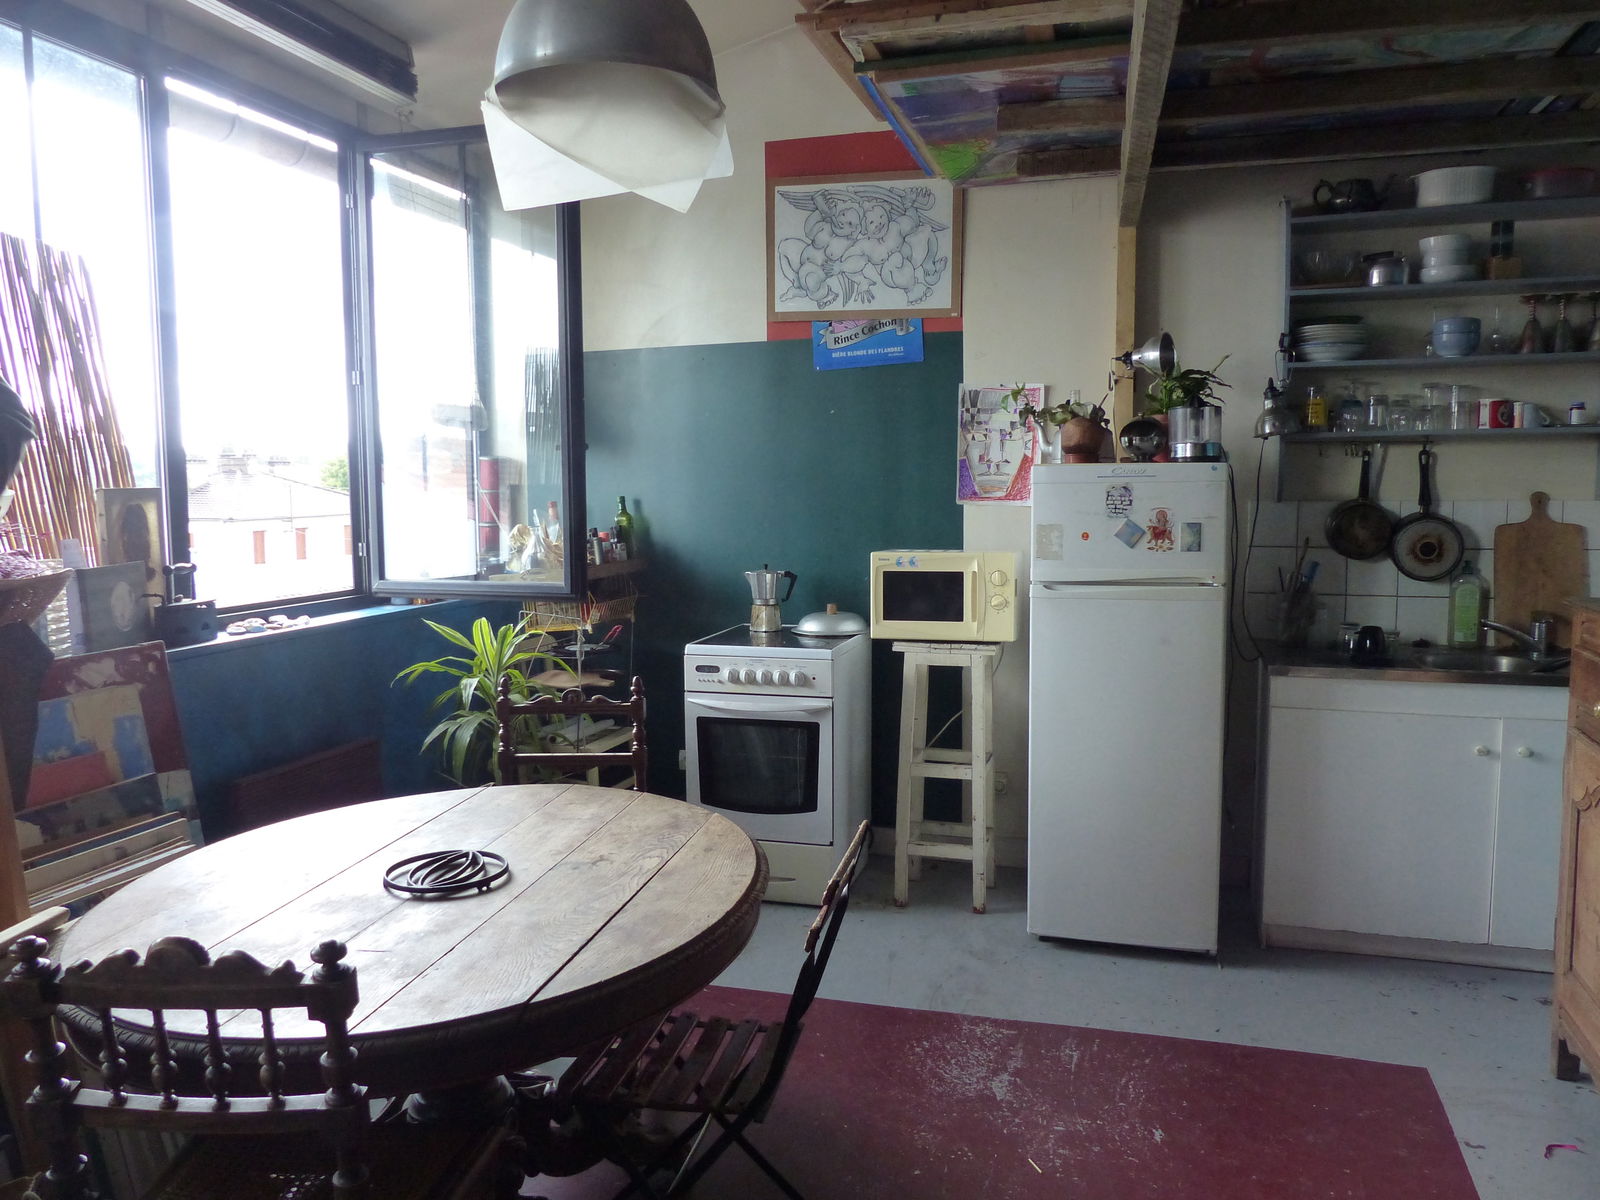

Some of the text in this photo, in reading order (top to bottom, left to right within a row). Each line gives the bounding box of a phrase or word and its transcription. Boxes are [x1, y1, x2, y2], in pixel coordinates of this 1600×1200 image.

[834, 319, 896, 345] Rince Cochon
[847, 349, 867, 357] BLONDE
[878, 346, 904, 354] FLANDRES
